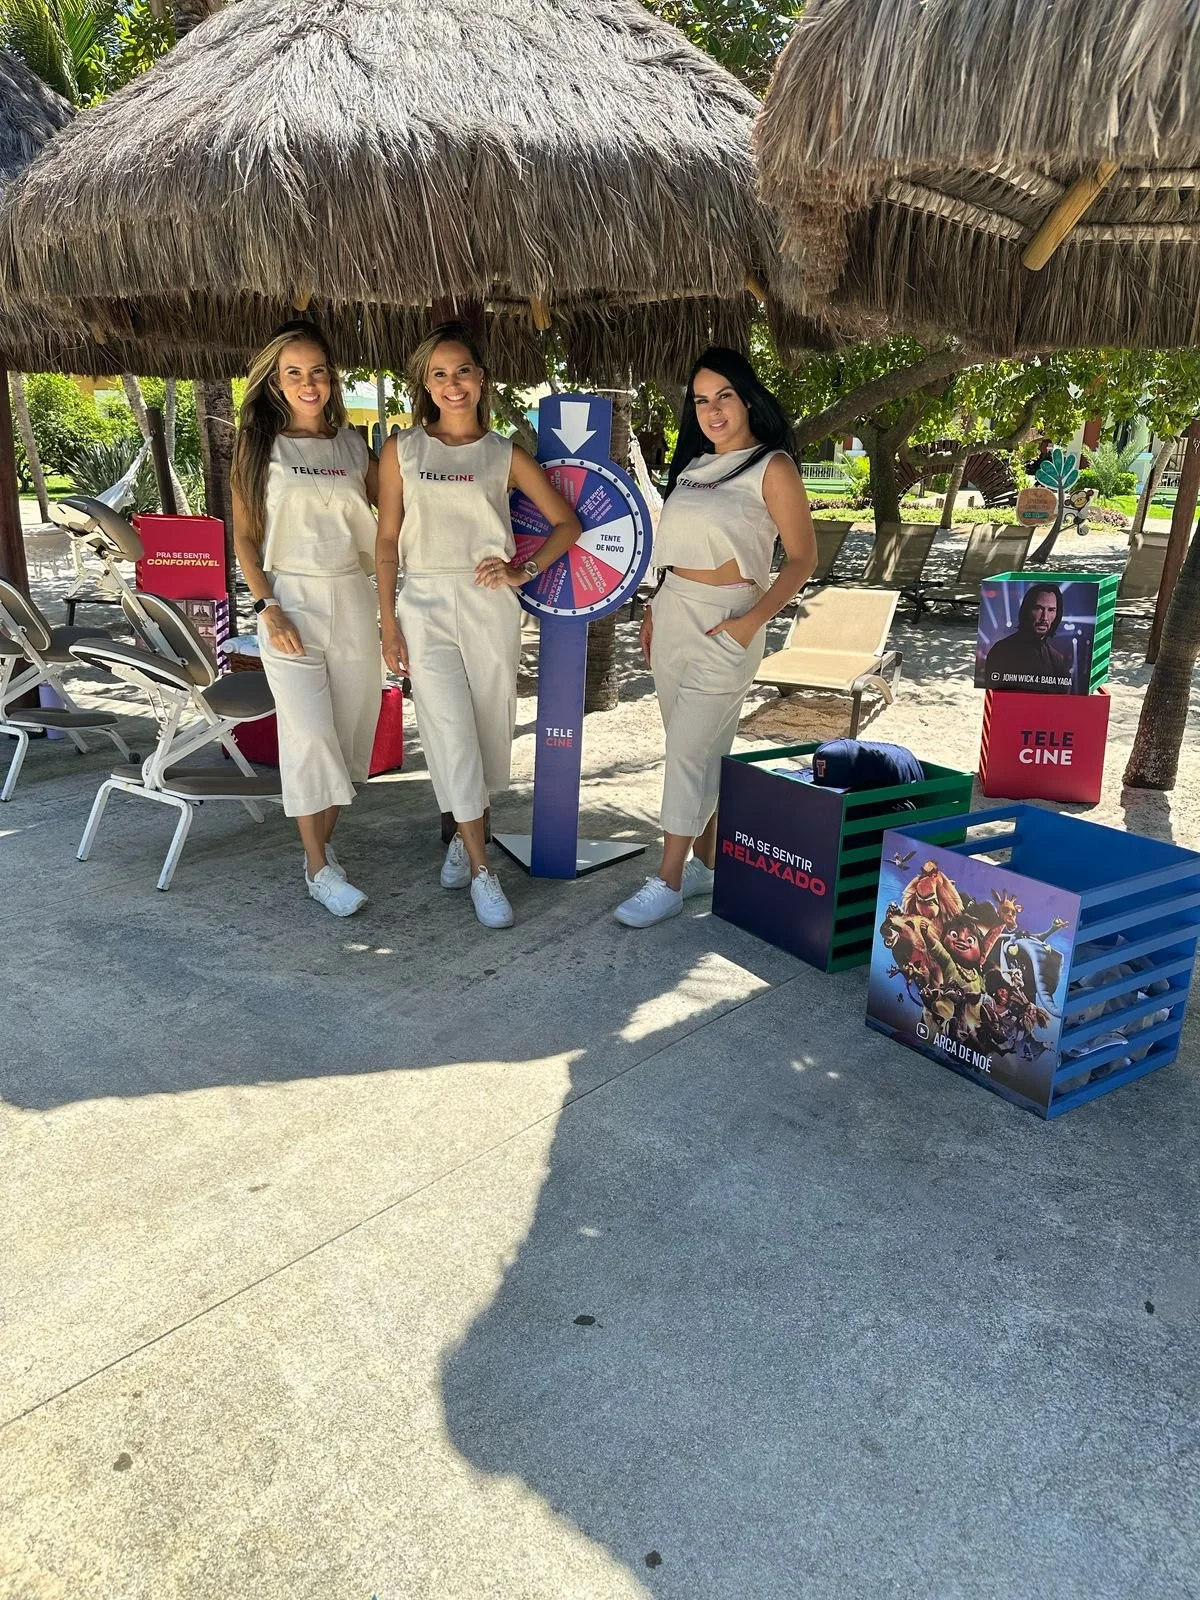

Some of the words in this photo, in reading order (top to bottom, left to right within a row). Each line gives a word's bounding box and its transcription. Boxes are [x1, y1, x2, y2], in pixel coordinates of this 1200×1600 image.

[292, 466, 347, 477] TELECINE
[419, 471, 475, 482] TELECINE
[582, 490, 606, 515] FELIZ
[601, 534, 621, 542] TENTE
[147, 558, 220, 566] CONFORTÁVEL
[580, 554, 605, 593] ANIMADO
[545, 561, 564, 605] RELAXADO
[1002, 673, 1017, 682] JOHN
[1018, 675, 1034, 683] WICK
[1041, 676, 1056, 684] BABA
[1057, 677, 1072, 686] YAGA
[546, 728, 573, 738] TELE
[1021, 731, 1074, 746] TELE
[545, 738, 573, 748] CINE
[1019, 748, 1073, 765] CINE
[735, 831, 755, 849] PRA
[756, 840, 770, 855] SE
[772, 846, 812, 872] SENTIR
[722, 840, 826, 896] RELAXADO
[933, 1032, 957, 1055] ARCA
[958, 1044, 971, 1062] DE
[972, 1051, 992, 1073] NOÉ
